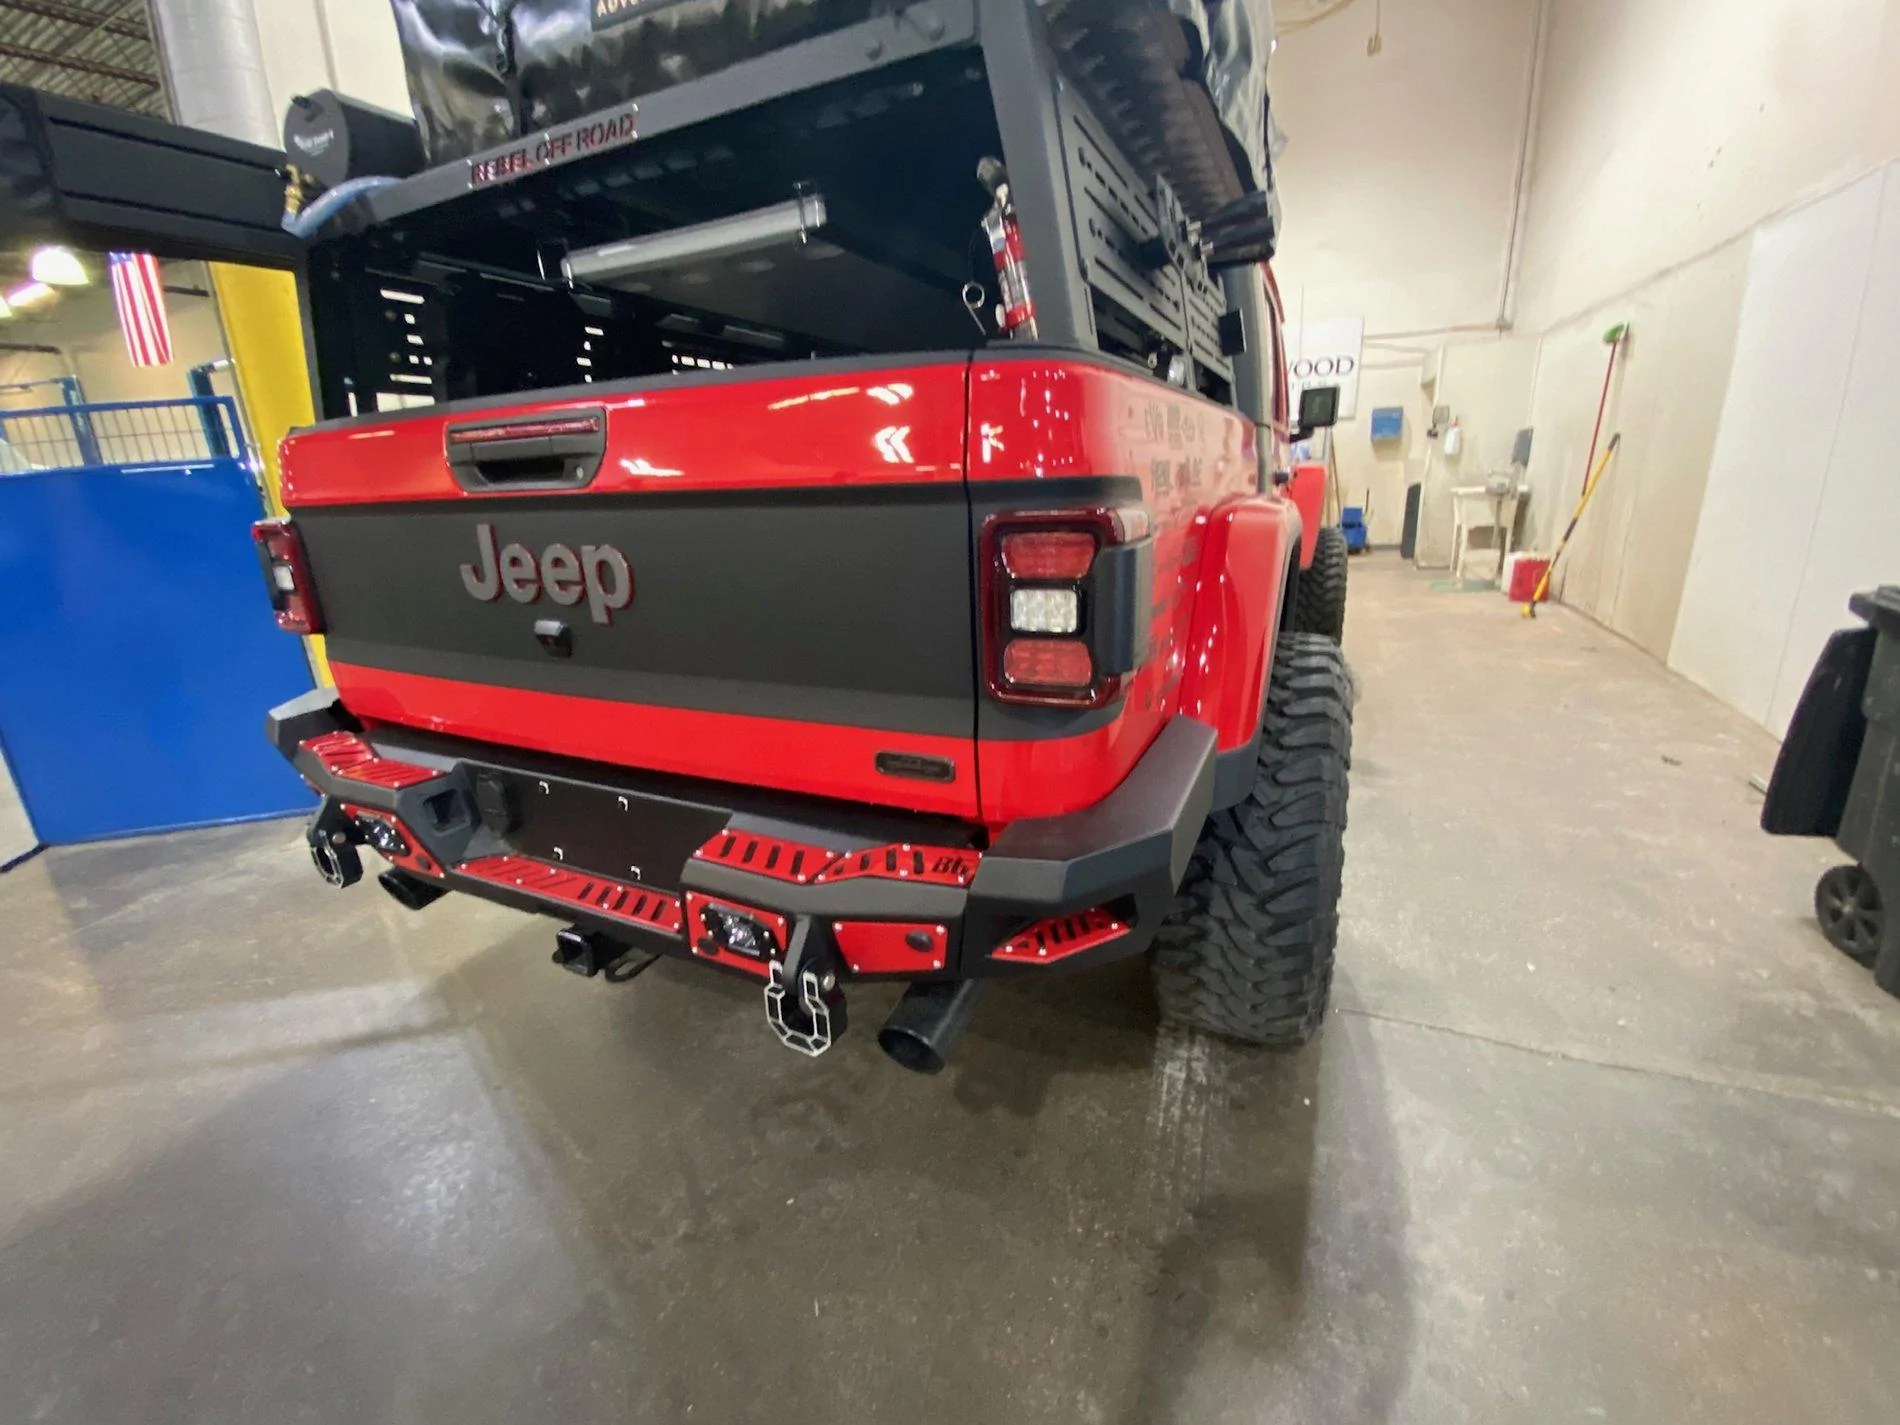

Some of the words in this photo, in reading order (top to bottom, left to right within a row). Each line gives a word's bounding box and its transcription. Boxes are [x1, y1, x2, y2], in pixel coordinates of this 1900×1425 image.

[472, 149, 532, 183] REBEL
[536, 132, 572, 161] OFF
[577, 114, 635, 149] ROAD
[1288, 355, 1354, 378] OOD
[460, 524, 634, 625] Jeep
